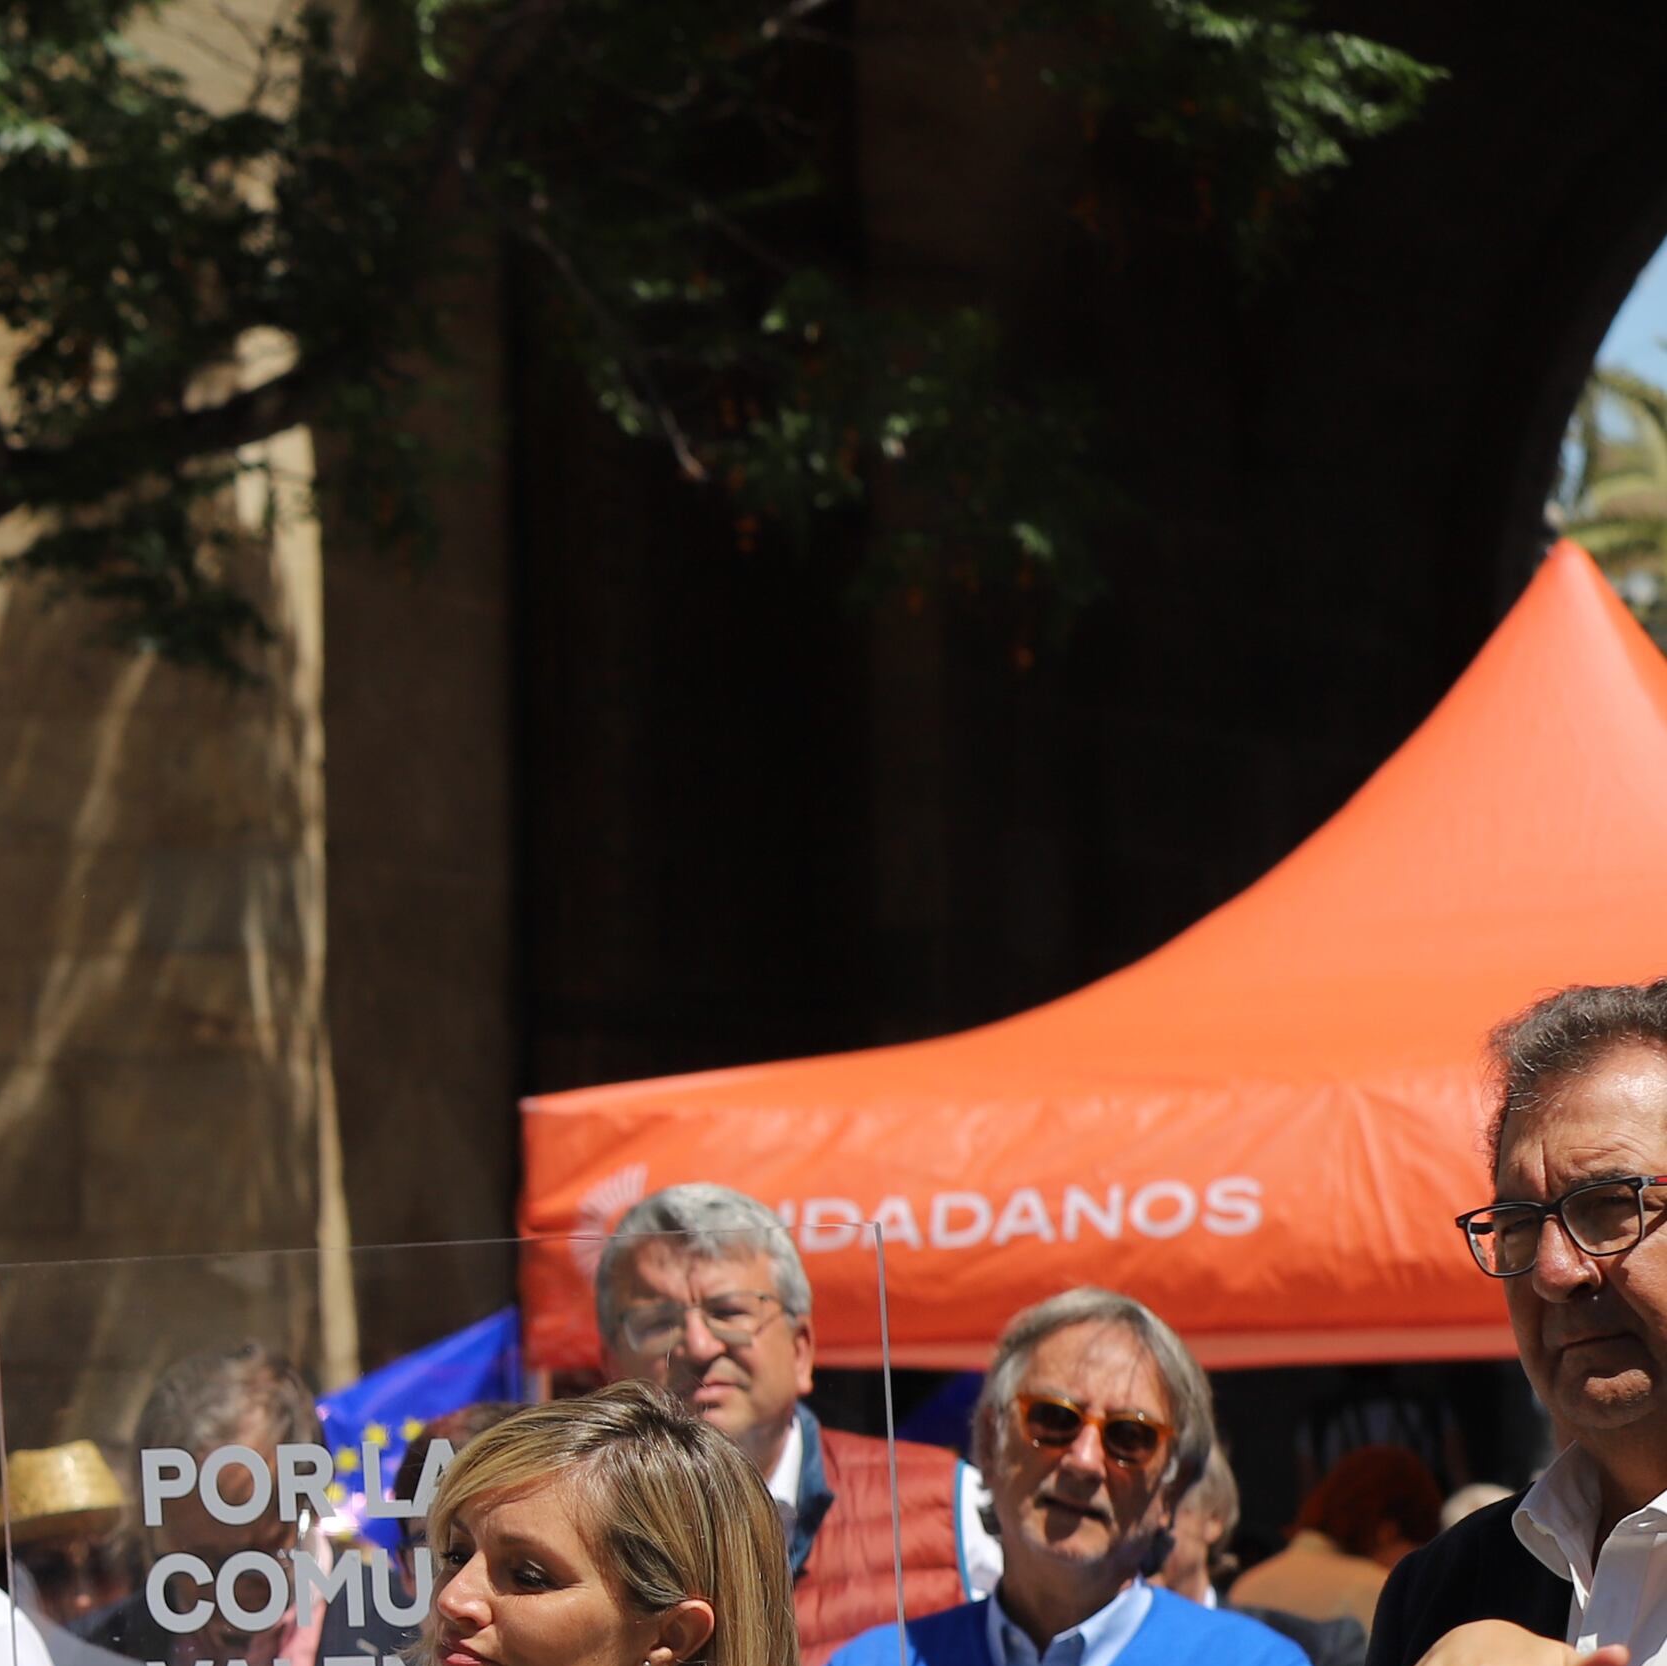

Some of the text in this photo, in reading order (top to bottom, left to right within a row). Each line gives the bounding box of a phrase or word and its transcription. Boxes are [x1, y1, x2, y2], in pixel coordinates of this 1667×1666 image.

[779, 1176, 1264, 1253] DADANOS
[141, 1444, 336, 1526] POR
[146, 1547, 433, 1633] COMU
